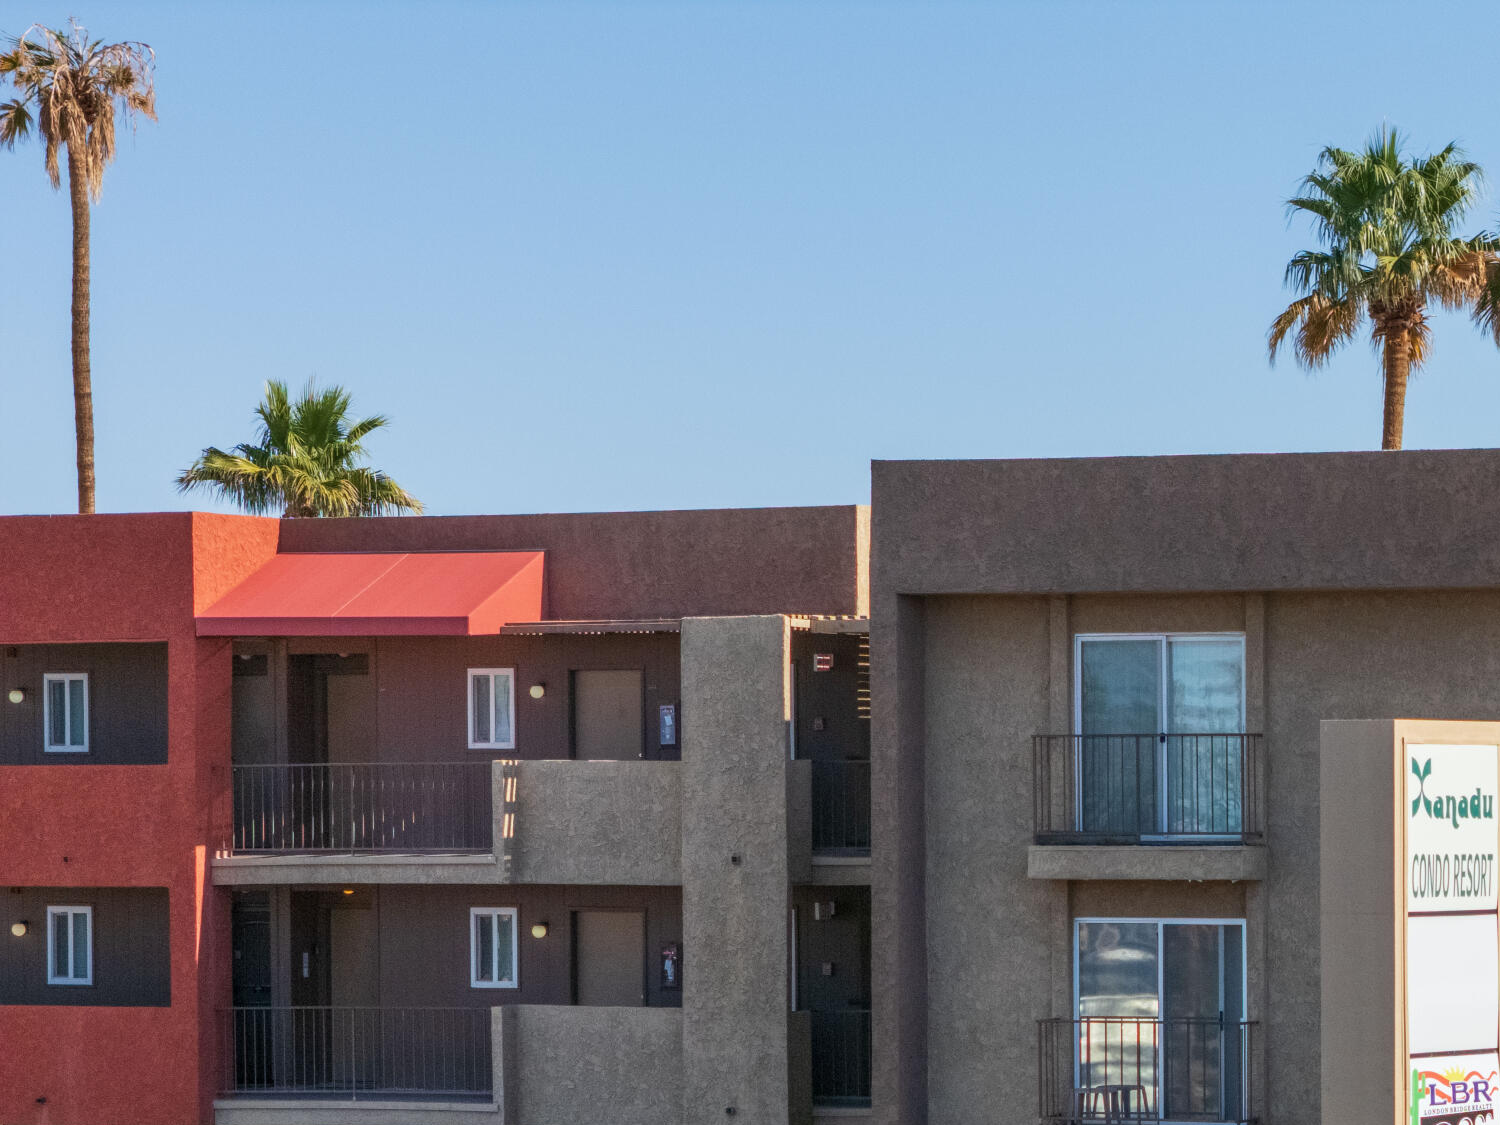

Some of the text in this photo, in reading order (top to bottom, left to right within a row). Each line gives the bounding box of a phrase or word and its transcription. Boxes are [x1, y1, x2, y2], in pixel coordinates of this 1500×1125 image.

[1412, 853, 1493, 898] CONDO RESORT
[1428, 1080, 1493, 1106] LBR
[1424, 1108, 1449, 1116] LONDON
